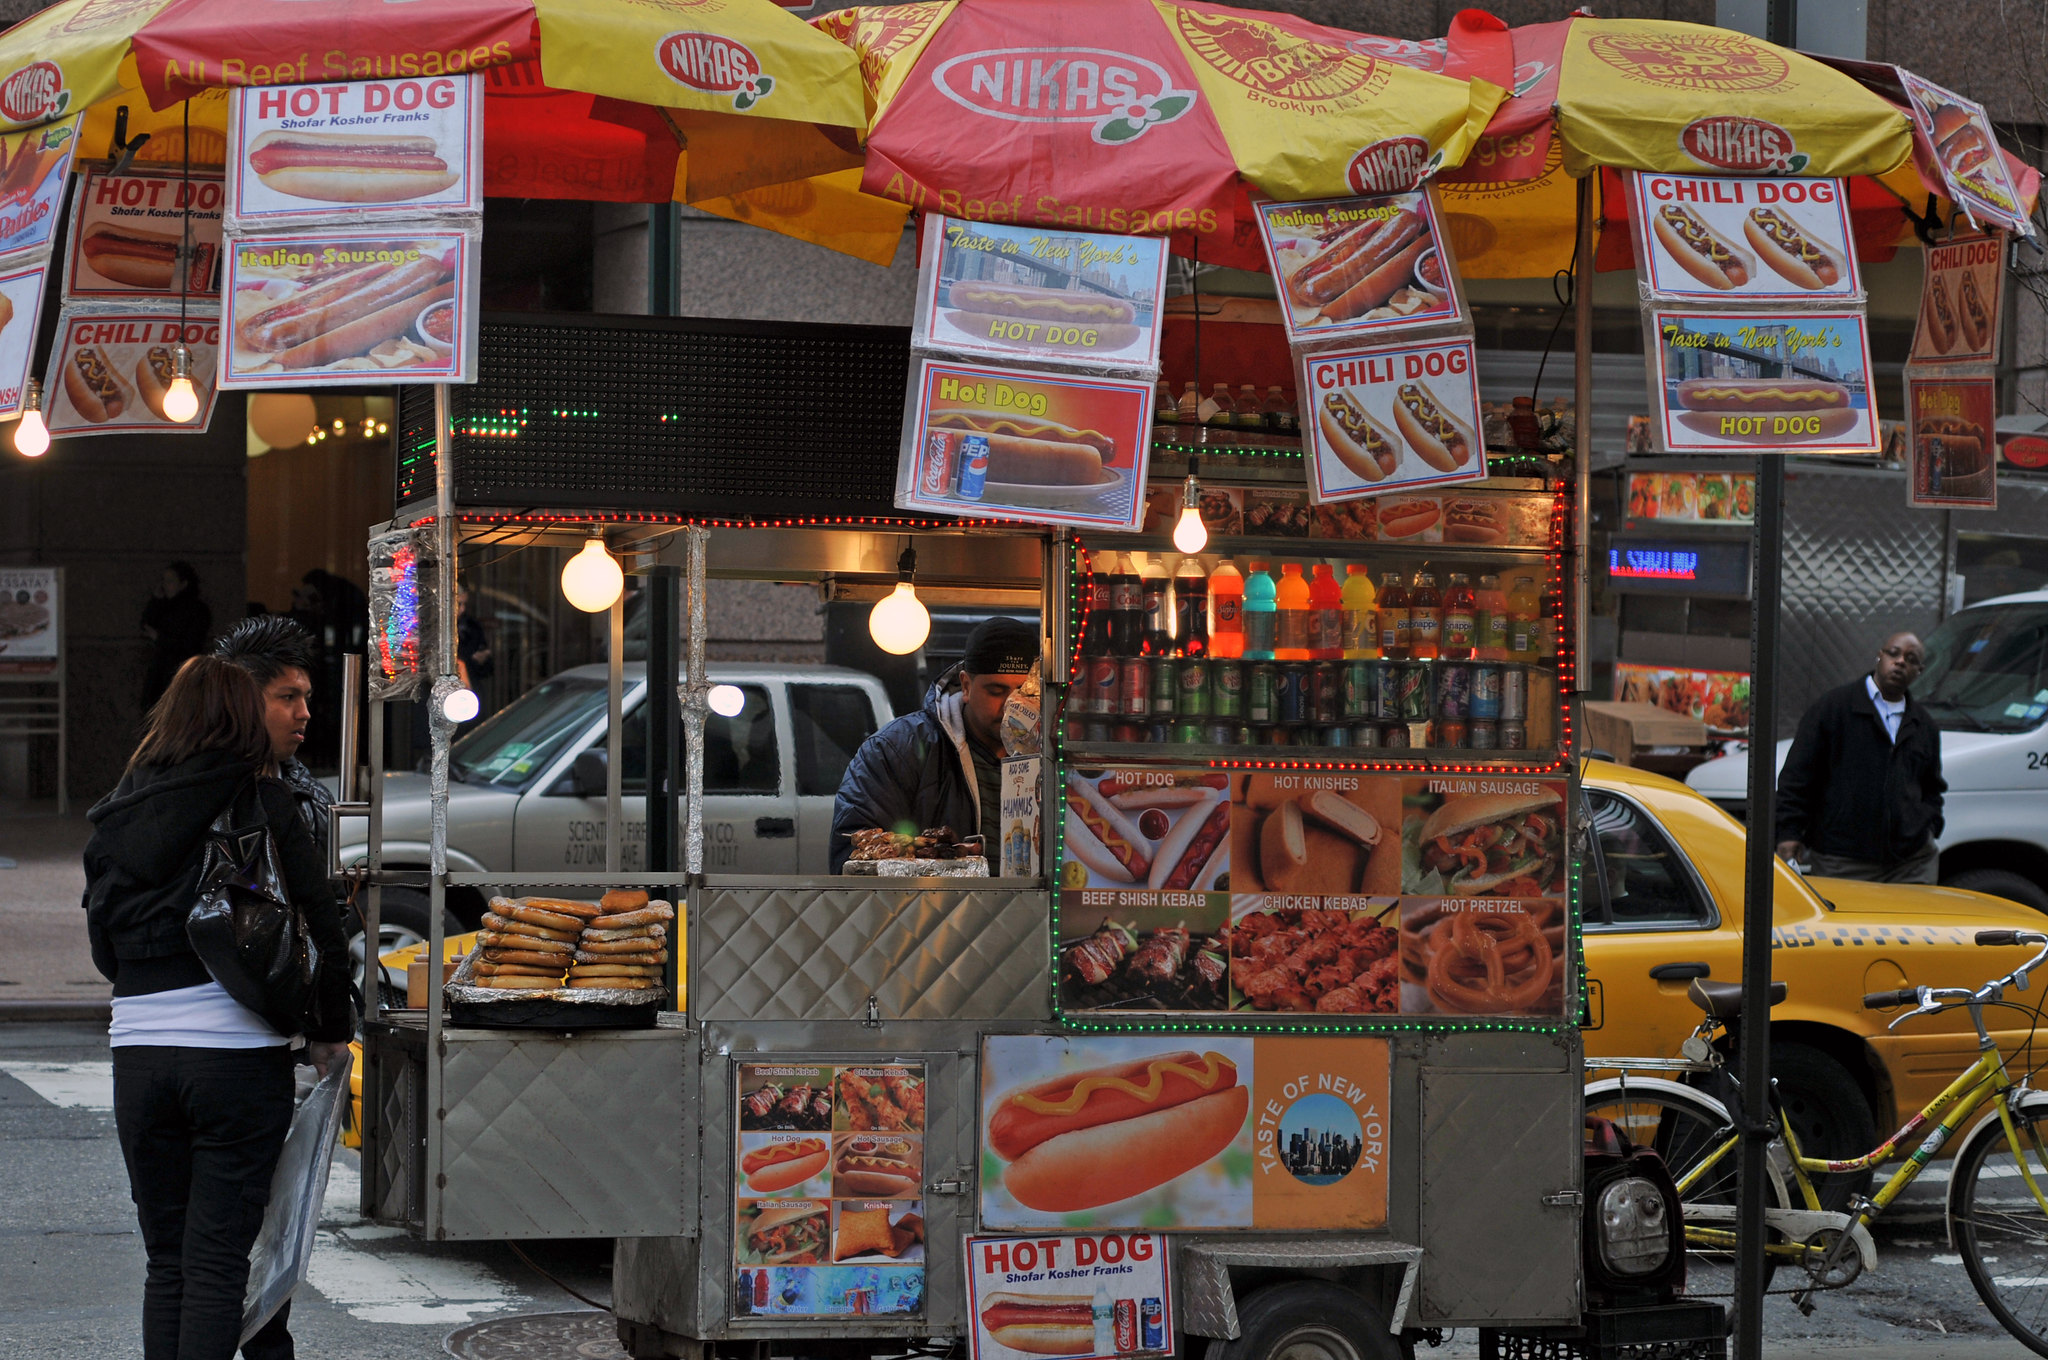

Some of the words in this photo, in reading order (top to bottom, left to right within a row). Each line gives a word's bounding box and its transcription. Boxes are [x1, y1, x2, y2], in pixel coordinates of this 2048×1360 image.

[165, 58, 206, 92] All
[222, 52, 307, 86] Beef
[322, 40, 513, 81] Sausages
[669, 36, 750, 86] NIKAS
[4, 66, 57, 115] NIKAS
[971, 58, 1138, 113] NIKAS
[258, 86, 349, 119] HOT
[363, 79, 456, 113] DOG
[280, 118, 326, 129] Shofar
[329, 114, 379, 126] Kosher
[382, 111, 430, 123] Franks
[696, 121, 782, 164] NIKAS
[1356, 142, 1427, 192] NIKAS
[96, 178, 167, 208] HOT
[174, 182, 225, 210] DO
[884, 171, 925, 209] All
[939, 188, 1024, 223] Beef
[1036, 196, 1218, 234] Sausages
[1651, 178, 1744, 203] CHILI
[1756, 182, 1835, 204] DOG
[111, 206, 145, 217] Shofar
[147, 208, 184, 219] Kosher
[187, 209, 221, 221] Franks
[1268, 208, 1325, 228] Italian
[1327, 203, 1400, 224] Sausage
[241, 248, 315, 268] Italian
[322, 247, 421, 267] Sausage
[946, 226, 995, 253] Taste
[1001, 239, 1021, 255] in
[1028, 235, 1071, 259] New
[1078, 239, 1140, 268] York's
[1931, 245, 1963, 271] CHILI
[1967, 240, 1999, 267] DOG
[74, 323, 153, 345] CHILI
[988, 320, 1041, 343] HOT
[1046, 326, 1098, 347] DOG
[1663, 324, 1709, 349] Taste
[1714, 330, 1731, 348] in
[1738, 326, 1778, 350] New
[1785, 325, 1843, 355] York's
[1316, 357, 1395, 390] CHILI
[1404, 350, 1468, 380] DOG
[939, 377, 986, 405] Hot
[994, 384, 1049, 417] Dog
[1720, 417, 1767, 436] HOT
[1773, 416, 1822, 436] DOG
[1115, 771, 1143, 785] HOT
[1146, 773, 1175, 787] DOG
[1274, 775, 1300, 790] HOT
[1303, 776, 1359, 791] KNISHES
[1428, 779, 1477, 794] ITALIAN
[1479, 780, 1540, 796] SAUSAGE
[1082, 891, 1116, 906] BEEF
[1119, 892, 1159, 907] SHISH
[1161, 893, 1206, 908] KEBAB
[1263, 895, 1321, 910] CHICKEN
[1323, 896, 1368, 911] KEBAB
[1440, 898, 1466, 913] HOT
[1469, 899, 1526, 914] PRETZEL
[755, 1067, 772, 1077] Beef
[773, 1067, 794, 1077] Shish
[796, 1067, 820, 1077] Kebab
[853, 1068, 884, 1077] Chicken
[885, 1069, 910, 1077] Kebab
[1257, 1098, 1285, 1176] TASTE
[1283, 1074, 1310, 1100] OF
[1317, 1072, 1367, 1105] NEW
[1360, 1103, 1384, 1175] YORK
[771, 1135, 785, 1143] Hot
[786, 1135, 801, 1143] Dog
[857, 1135, 870, 1143] Hot
[871, 1136, 904, 1144] Sausage
[757, 1201, 779, 1209] Italian
[781, 1201, 812, 1210] Sausage
[863, 1202, 893, 1210] Knishes
[983, 1238, 1062, 1275] HOT
[1074, 1234, 1154, 1267] DOG
[1006, 1271, 1045, 1283] Shofar
[1048, 1269, 1090, 1280] Kosher
[1093, 1264, 1133, 1276] Franks
